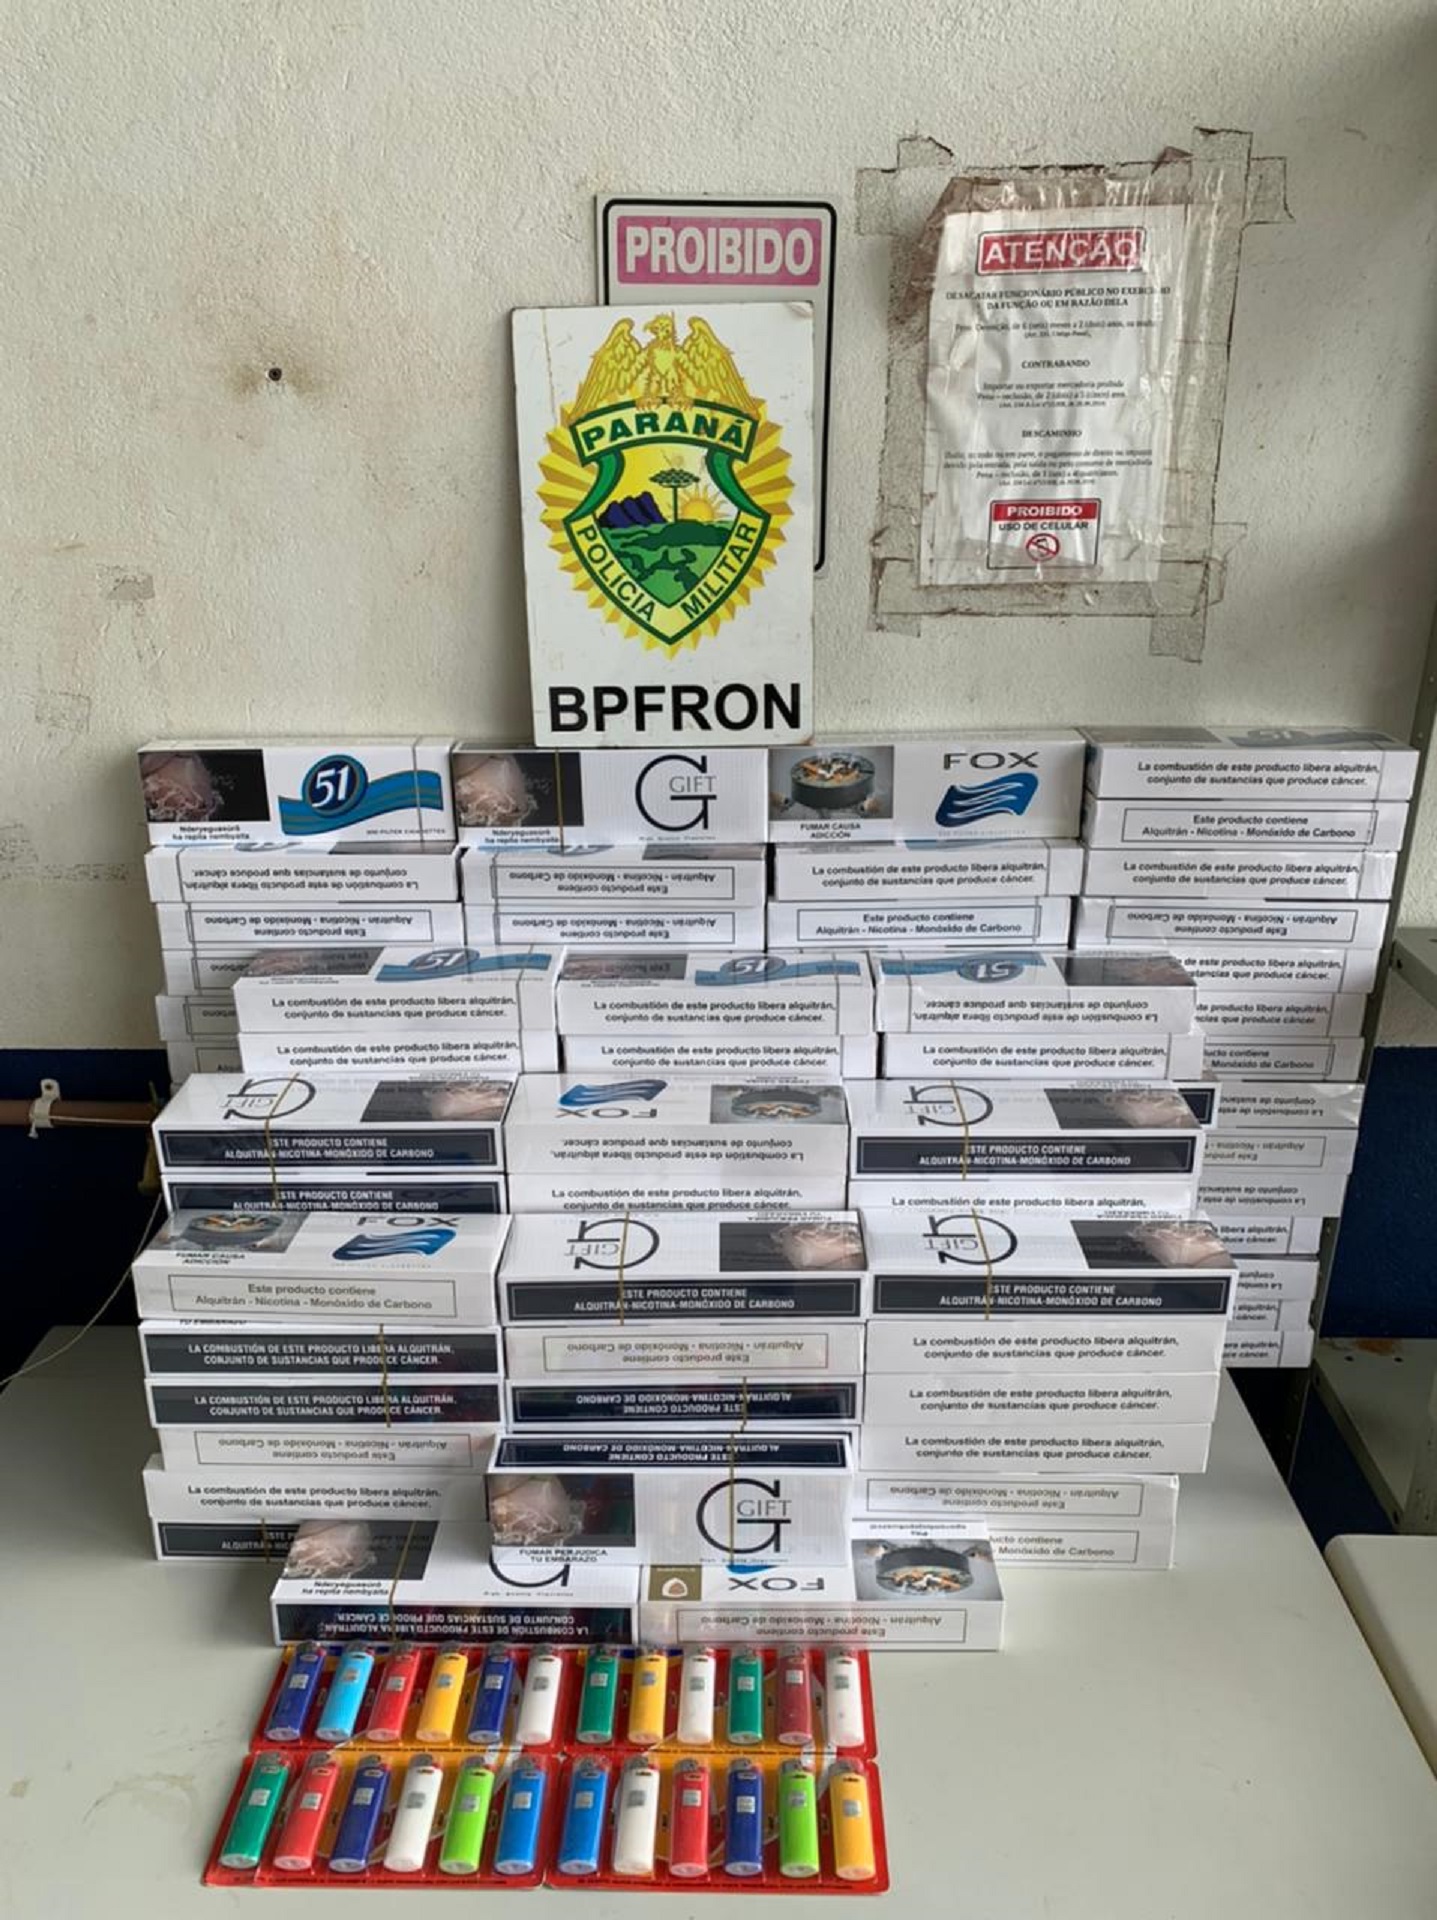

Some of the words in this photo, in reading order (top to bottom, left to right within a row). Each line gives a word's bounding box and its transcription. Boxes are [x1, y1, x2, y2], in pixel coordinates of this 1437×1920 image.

[625, 227, 814, 276] PROIBIDO
[985, 234, 1137, 266] ATENÇÃO
[1001, 289, 1063, 299] FUNCIONÁRIO
[1065, 287, 1104, 297] PÚBLICO
[1000, 299, 1039, 311] FUNÇÃO
[1041, 300, 1053, 308] OU
[1055, 299, 1069, 308] EM
[1071, 298, 1102, 308] RAZÃO
[1103, 298, 1128, 307] DELA
[1021, 359, 1091, 369] CONTRABANDO
[583, 411, 748, 452] PARANÁ
[1022, 430, 1083, 438] DESCAMINHO
[1007, 505, 1083, 517] PROIBIDO
[998, 522, 1021, 531] USO
[1023, 522, 1037, 531] DE
[1040, 521, 1089, 530] CELULAR
[575, 524, 657, 624] POLÍCIA
[681, 522, 759, 623] MILITAR
[549, 683, 801, 733] BPFRON
[943, 751, 1039, 771] FOX
[1137, 762, 1151, 771] La
[1152, 762, 1213, 771] combustión
[1214, 762, 1229, 771] de
[1230, 763, 1252, 771] este
[1253, 763, 1301, 773] producto
[1302, 763, 1331, 772] libera
[669, 775, 717, 794] GIFT
[1146, 775, 1192, 785] conjunto
[1193, 775, 1207, 783] de
[1208, 776, 1263, 784] sustancias
[1265, 776, 1285, 786] que
[1286, 776, 1329, 786] produce
[312, 765, 350, 808] 51
[1193, 814, 1215, 824] Este
[1216, 815, 1263, 824] producto
[1264, 816, 1308, 824] contiene
[801, 823, 830, 831] FUMAR
[832, 822, 861, 831] CAUSA
[1141, 826, 1188, 836] Alquitrán
[1196, 827, 1238, 836] Nicotina
[1246, 827, 1295, 836] Monóxido
[1296, 827, 1310, 836] de
[1312, 827, 1356, 837] Carbono
[811, 831, 851, 839] ADICCIÓN
[811, 866, 824, 875] La
[826, 865, 884, 874] combustión
[886, 865, 899, 873] de
[900, 865, 921, 873] este
[923, 863, 968, 874] producto
[970, 862, 998, 872] libera
[821, 878, 865, 888] conjunto
[866, 877, 879, 885] de
[881, 876, 933, 885] sustancias
[935, 877, 954, 885] que
[956, 875, 997, 885] produce
[593, 1001, 606, 1009] La
[608, 1001, 668, 1010] combustión
[670, 1001, 684, 1010] de
[685, 1001, 708, 1010] este
[709, 1001, 755, 1010] producto
[757, 1001, 786, 1010] libera
[604, 1013, 649, 1022] conjunto
[650, 1013, 664, 1022] de
[722, 1014, 742, 1022] que
[743, 1013, 786, 1022] produce
[555, 1108, 658, 1119] FOX
[356, 1216, 461, 1227] FOX
[564, 1244, 619, 1256] GIFT
[924, 1239, 979, 1250] GIFT
[646, 1288, 698, 1298] PRODUCTO
[700, 1288, 746, 1297] CONTIENE
[733, 1299, 746, 1308] DE
[748, 1299, 794, 1308] CARBONO
[912, 1338, 927, 1346] La
[929, 1337, 995, 1346] combustión
[997, 1337, 1012, 1345] de
[1013, 1337, 1038, 1345] este
[1040, 1336, 1091, 1346] producto
[1093, 1336, 1125, 1345] libera
[188, 1344, 201, 1352] LA
[202, 1344, 265, 1352] COMBUSTIÓN
[267, 1344, 278, 1353] DE
[282, 1344, 304, 1352] ESTE
[307, 1344, 359, 1353] PRODUCTO
[923, 1349, 973, 1359] conjunto
[974, 1349, 989, 1358] de
[992, 1349, 1051, 1358] sustancias
[1053, 1350, 1075, 1358] que
[1077, 1348, 1123, 1358] produce
[203, 1355, 254, 1364] CONJUNTO
[256, 1355, 268, 1364] DE
[271, 1355, 329, 1364] SUSTANCIAS
[331, 1355, 350, 1364] QUE
[737, 1499, 792, 1517] GIFT
[555, 1549, 608, 1557] PERJUDICA
[727, 1576, 826, 1592] FOX
